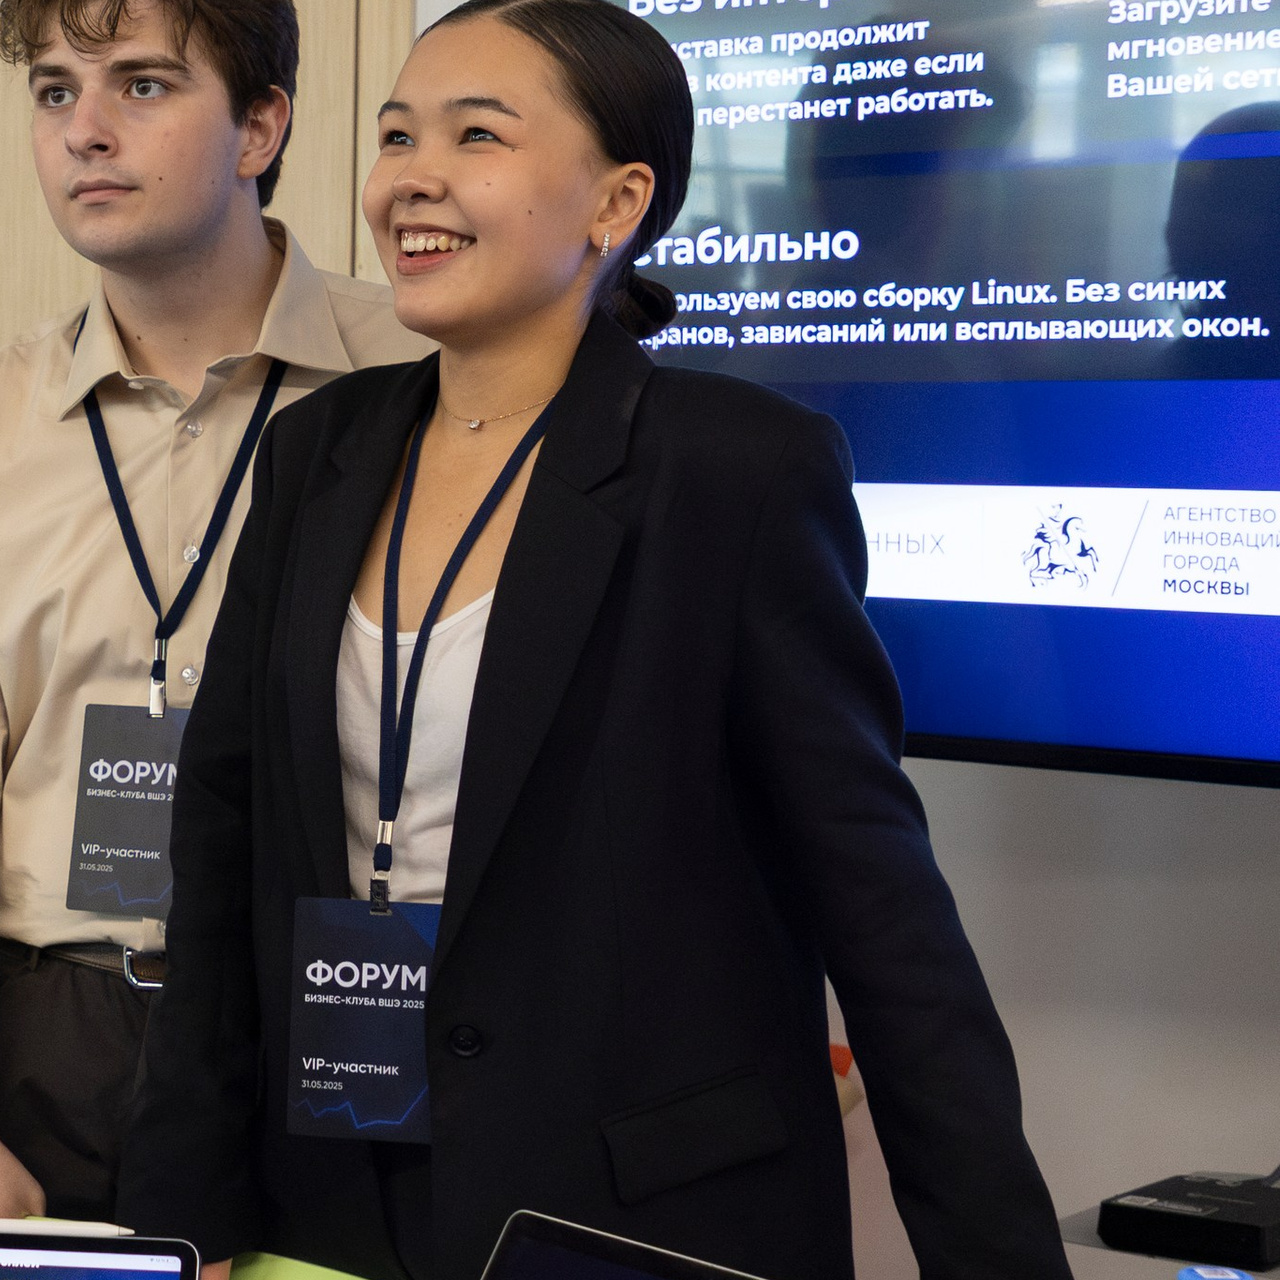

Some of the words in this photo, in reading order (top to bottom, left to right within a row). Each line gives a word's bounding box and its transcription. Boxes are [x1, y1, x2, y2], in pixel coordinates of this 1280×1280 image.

[670, 35, 764, 61] ставка
[770, 21, 930, 56] продолжит
[1108, 29, 1280, 61] мгновение
[706, 65, 827, 92] контента
[833, 57, 907, 85] даже
[914, 52, 984, 75] если
[1107, 66, 1213, 98] Вашей
[1222, 67, 1280, 90] сет
[697, 97, 851, 129] перестанет
[858, 88, 994, 120] работать.
[786, 288, 857, 310] свою
[863, 282, 965, 312] сборку
[972, 278, 1058, 304] Linux.
[1065, 279, 1121, 303] Без
[1127, 280, 1227, 301] синих
[740, 318, 885, 343] зависаний
[893, 322, 947, 342] или
[955, 318, 1175, 341] всплывающих
[1182, 317, 1270, 337] окон.
[1164, 506, 1276, 523] АГЕНТСТВО
[1163, 554, 1240, 573] ГОРОДА
[1163, 579, 1249, 595] МОСКВЫ
[86, 788, 146, 800] БИЗНЕС-КЛУБА
[147, 792, 166, 801] ВШЭ
[81, 843, 161, 860] VIP-участник
[79, 862, 114, 873] 31.05.2025
[306, 959, 427, 992] ФОРУМ
[304, 993, 376, 1006] БИЗНЕС-КЛУБА
[378, 998, 401, 1008] ВШЭ
[402, 1000, 425, 1009] 2025
[302, 1057, 400, 1076] VIP-участник
[301, 1079, 344, 1091] 31.05.2025
